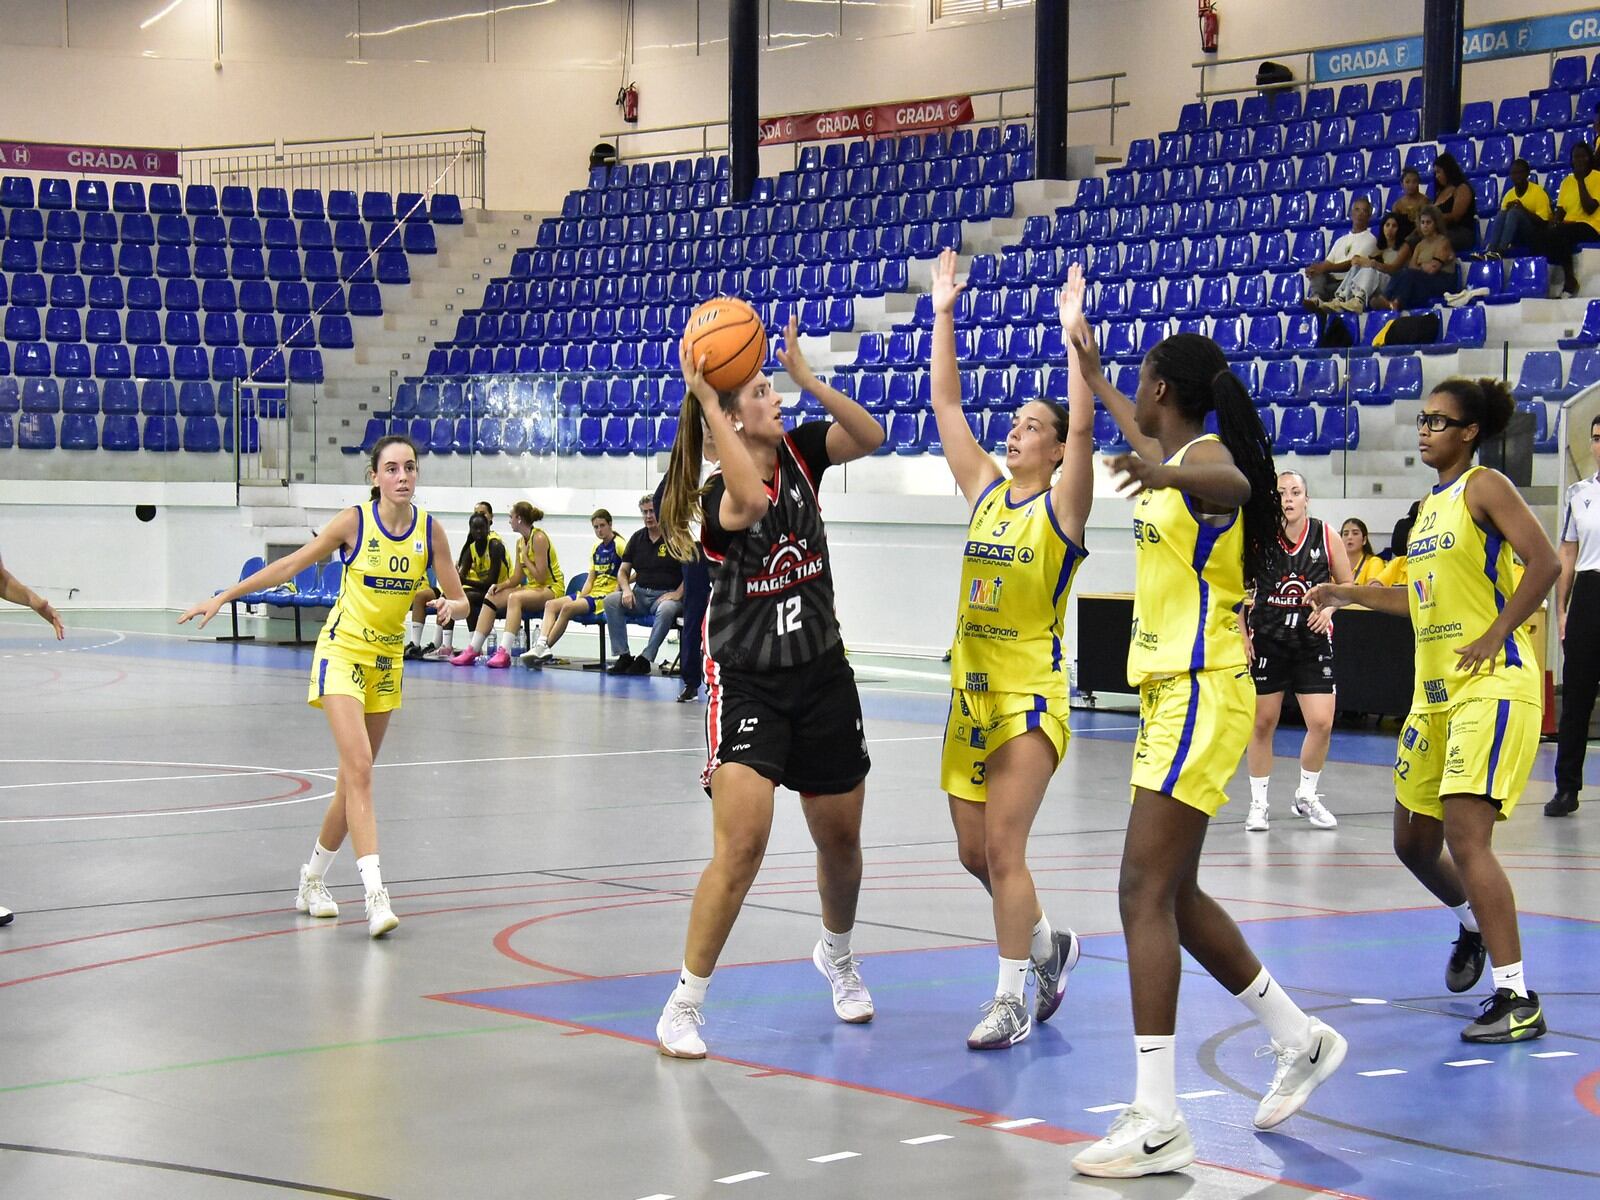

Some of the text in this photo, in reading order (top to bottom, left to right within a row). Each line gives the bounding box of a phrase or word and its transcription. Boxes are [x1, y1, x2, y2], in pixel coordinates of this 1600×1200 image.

[1568, 18, 1600, 40] GR
[1462, 31, 1509, 55] RADA
[1329, 48, 1390, 74] GRADA
[895, 103, 944, 125] GRADA
[758, 123, 781, 139] ADA
[816, 114, 860, 134] GRADA
[67, 151, 138, 170] GRADA
[992, 521, 1011, 537] 3
[1419, 511, 1437, 534] 22
[968, 543, 1014, 559] SPAR
[389, 555, 410, 573] 00
[375, 578, 413, 589] SPAR
[747, 557, 823, 594] MAGEC TIAS
[1267, 595, 1298, 606] MAGEC
[776, 595, 803, 636] 12
[1284, 613, 1299, 629] 11
[965, 621, 982, 632] Gran
[983, 624, 1018, 638] Canaria
[1429, 621, 1462, 634] Canaria
[1258, 656, 1268, 669] 11
[966, 672, 988, 683] BASKET
[1423, 678, 1445, 692] BASKET
[1425, 688, 1449, 704] 1980
[970, 761, 986, 785] 3
